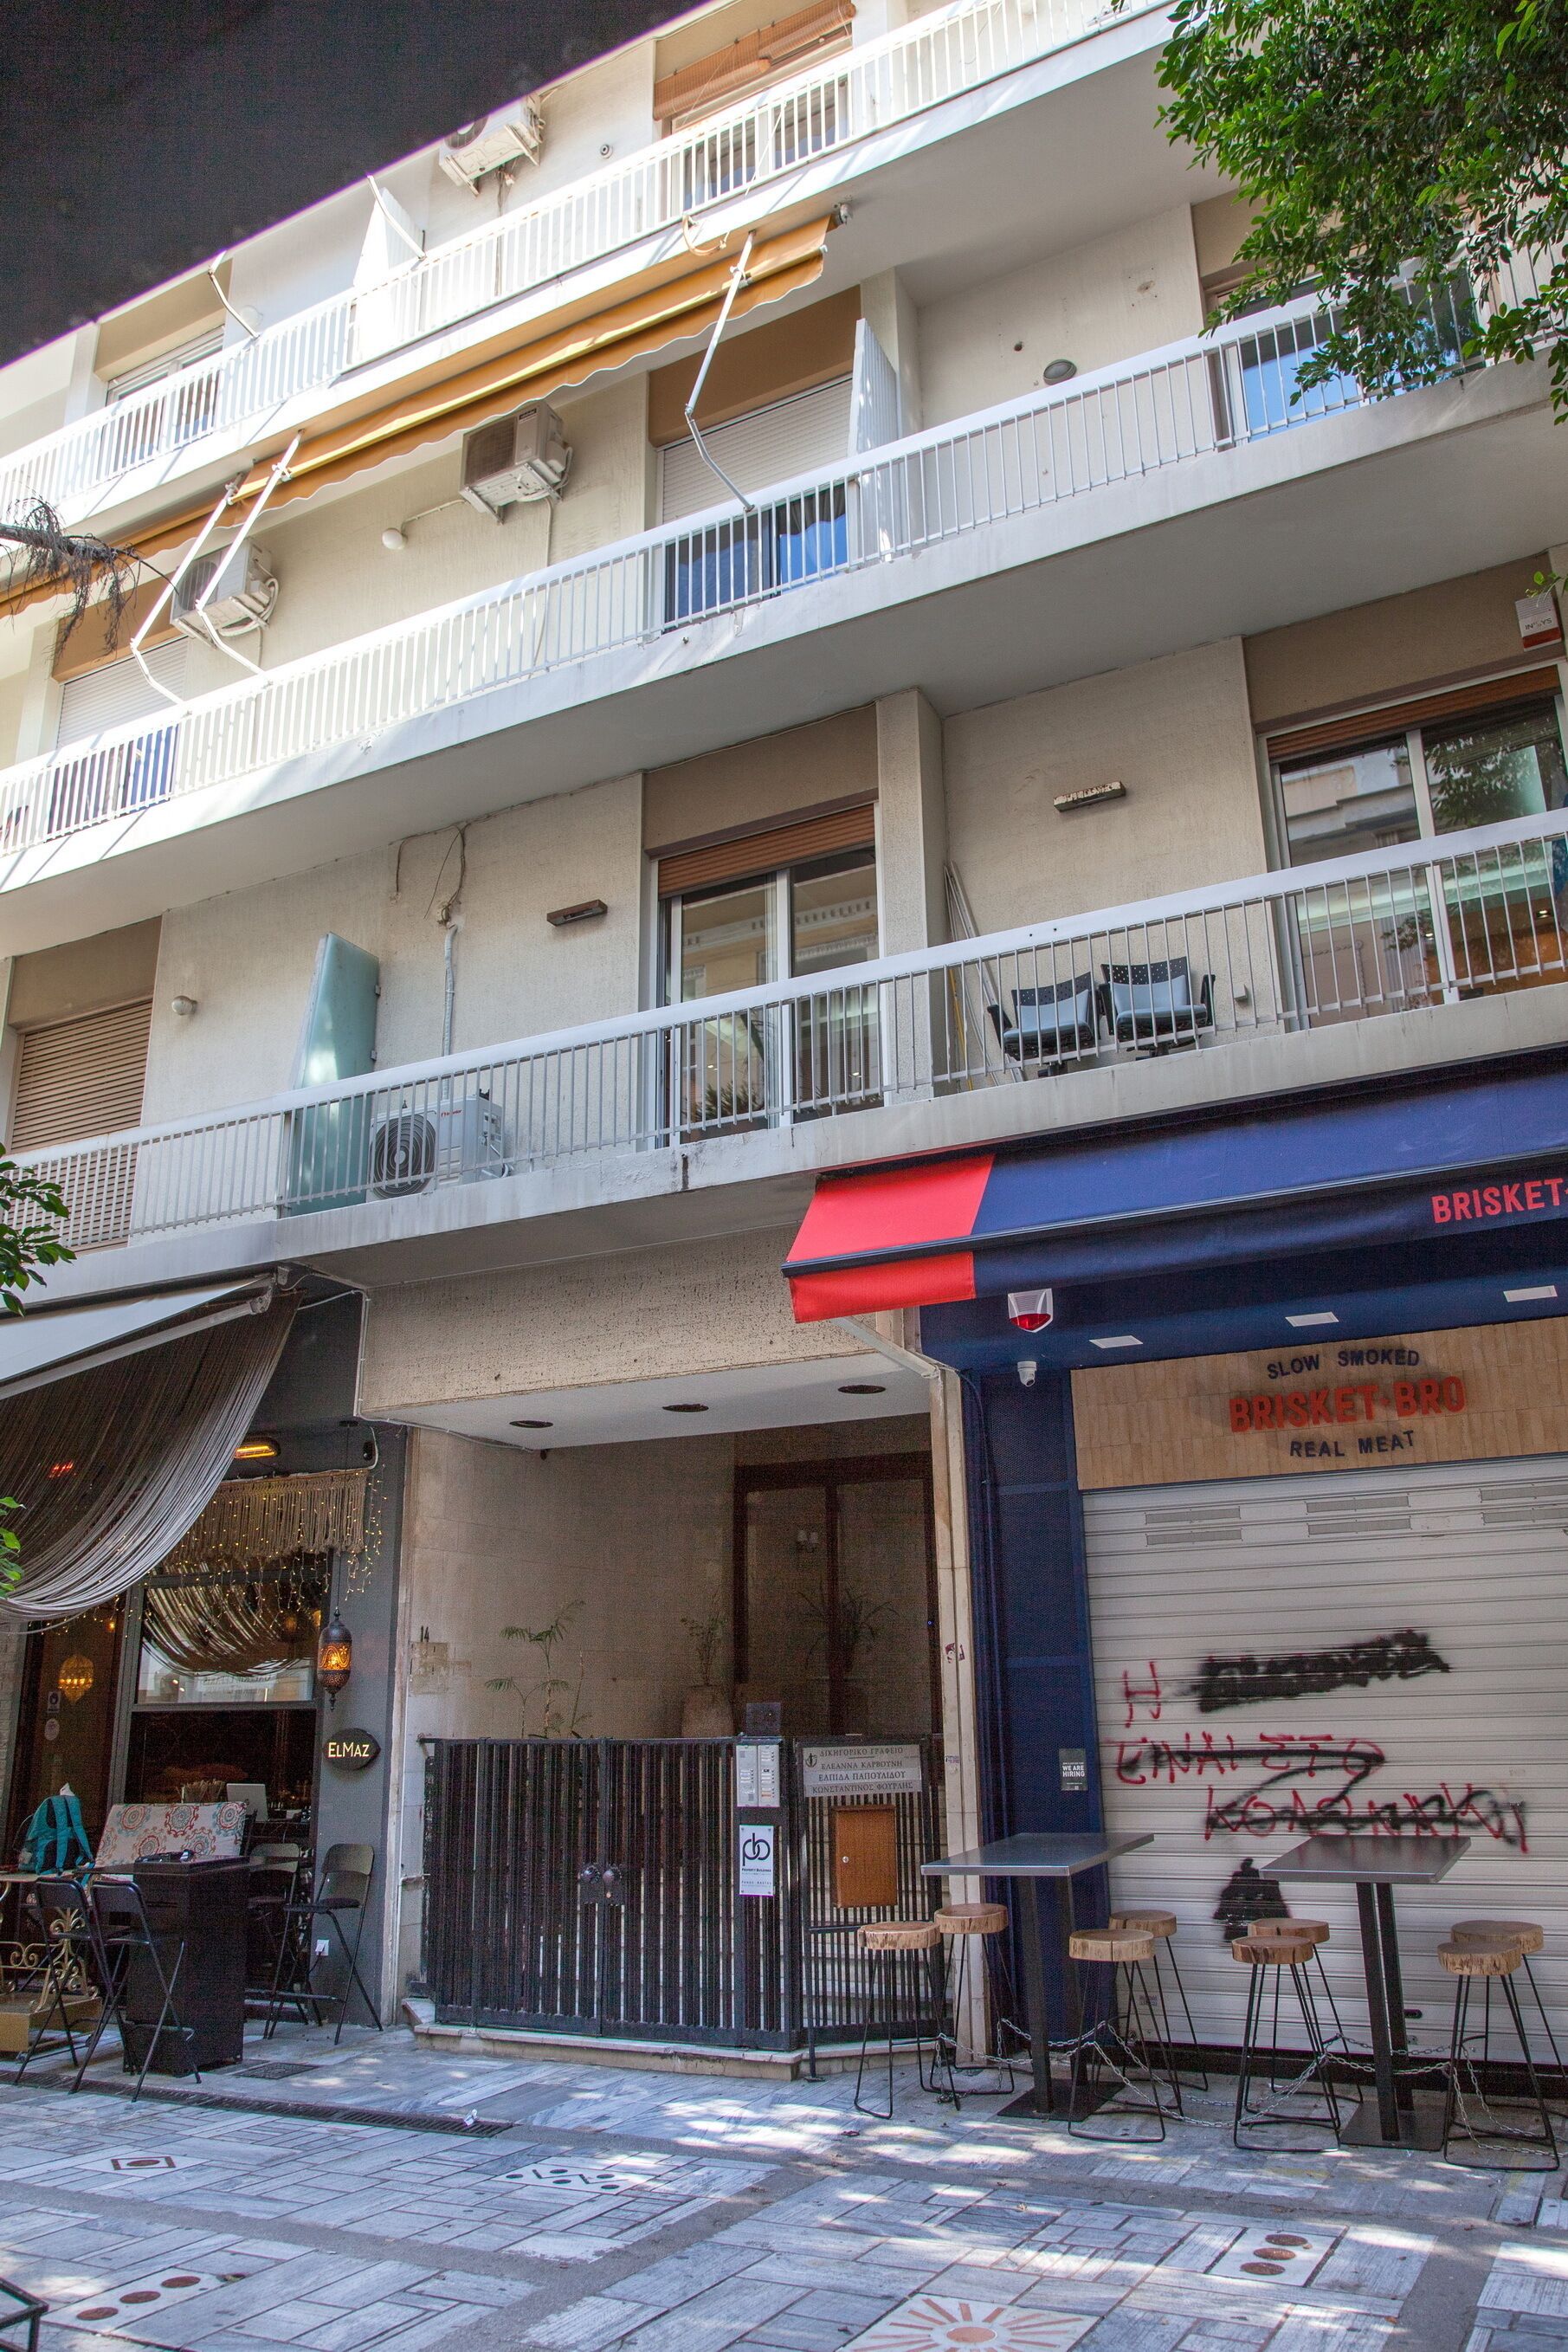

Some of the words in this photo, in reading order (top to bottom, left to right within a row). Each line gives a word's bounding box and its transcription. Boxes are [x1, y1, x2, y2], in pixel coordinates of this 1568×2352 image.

[1431, 1178, 1564, 1224] BRISKET
[1267, 1354, 1320, 1380] SLOW
[1338, 1348, 1420, 1367] SMOKED
[1229, 1385, 1379, 1432] BRISKET
[1393, 1376, 1467, 1418] BRO
[1289, 1441, 1345, 1457] REAL
[1358, 1431, 1415, 1454] MEAT
[420, 1625, 429, 1642] 14
[819, 1748, 868, 1757] ΔΙΚΗΓΟΡΙΚΟ
[821, 1761, 858, 1770] ΕΛΕΑΝΝΑ
[852, 1771, 906, 1780] ΠΑΠΟΥΛΙΔΟΥ
[812, 1784, 874, 1793] ΚΩΝΣΤΑΝΤΙΝΟΣ
